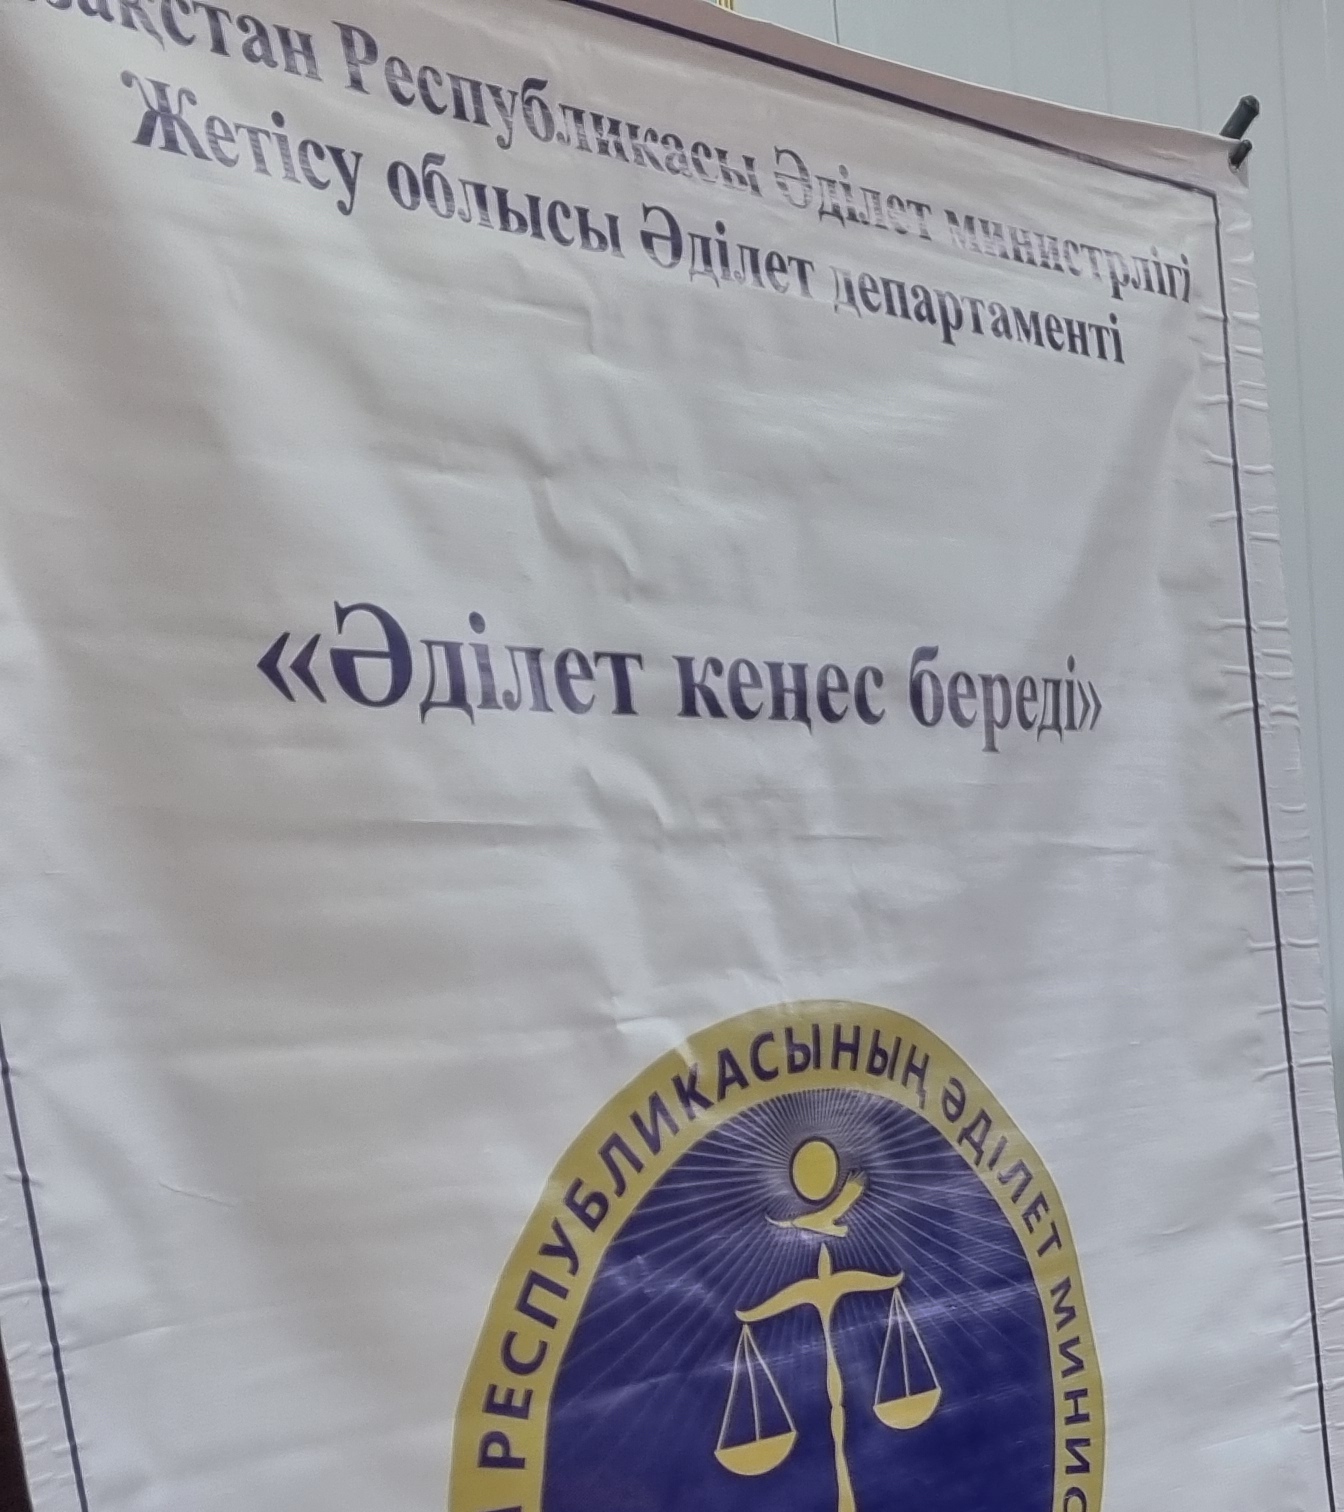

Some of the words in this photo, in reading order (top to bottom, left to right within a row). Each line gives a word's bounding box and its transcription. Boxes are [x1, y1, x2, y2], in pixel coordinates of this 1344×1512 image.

[25, 0, 323, 81] қстан
[332, 20, 764, 198] Республикасы
[774, 145, 932, 242] Әділет
[944, 208, 1192, 303] министрлігі
[120, 69, 363, 216] Жетісу
[387, 154, 625, 259] облысы
[641, 202, 815, 289] Әділет
[829, 263, 1125, 364] департаменті
[256, 600, 643, 724] «Әділет
[672, 653, 886, 736] кеңес
[907, 645, 1103, 753] береді»
[478, 1023, 932, 1471] РЕСПУБЛИКАСЫНЫҢ
[942, 1076, 1062, 1259] ӘДІЛЕТ
